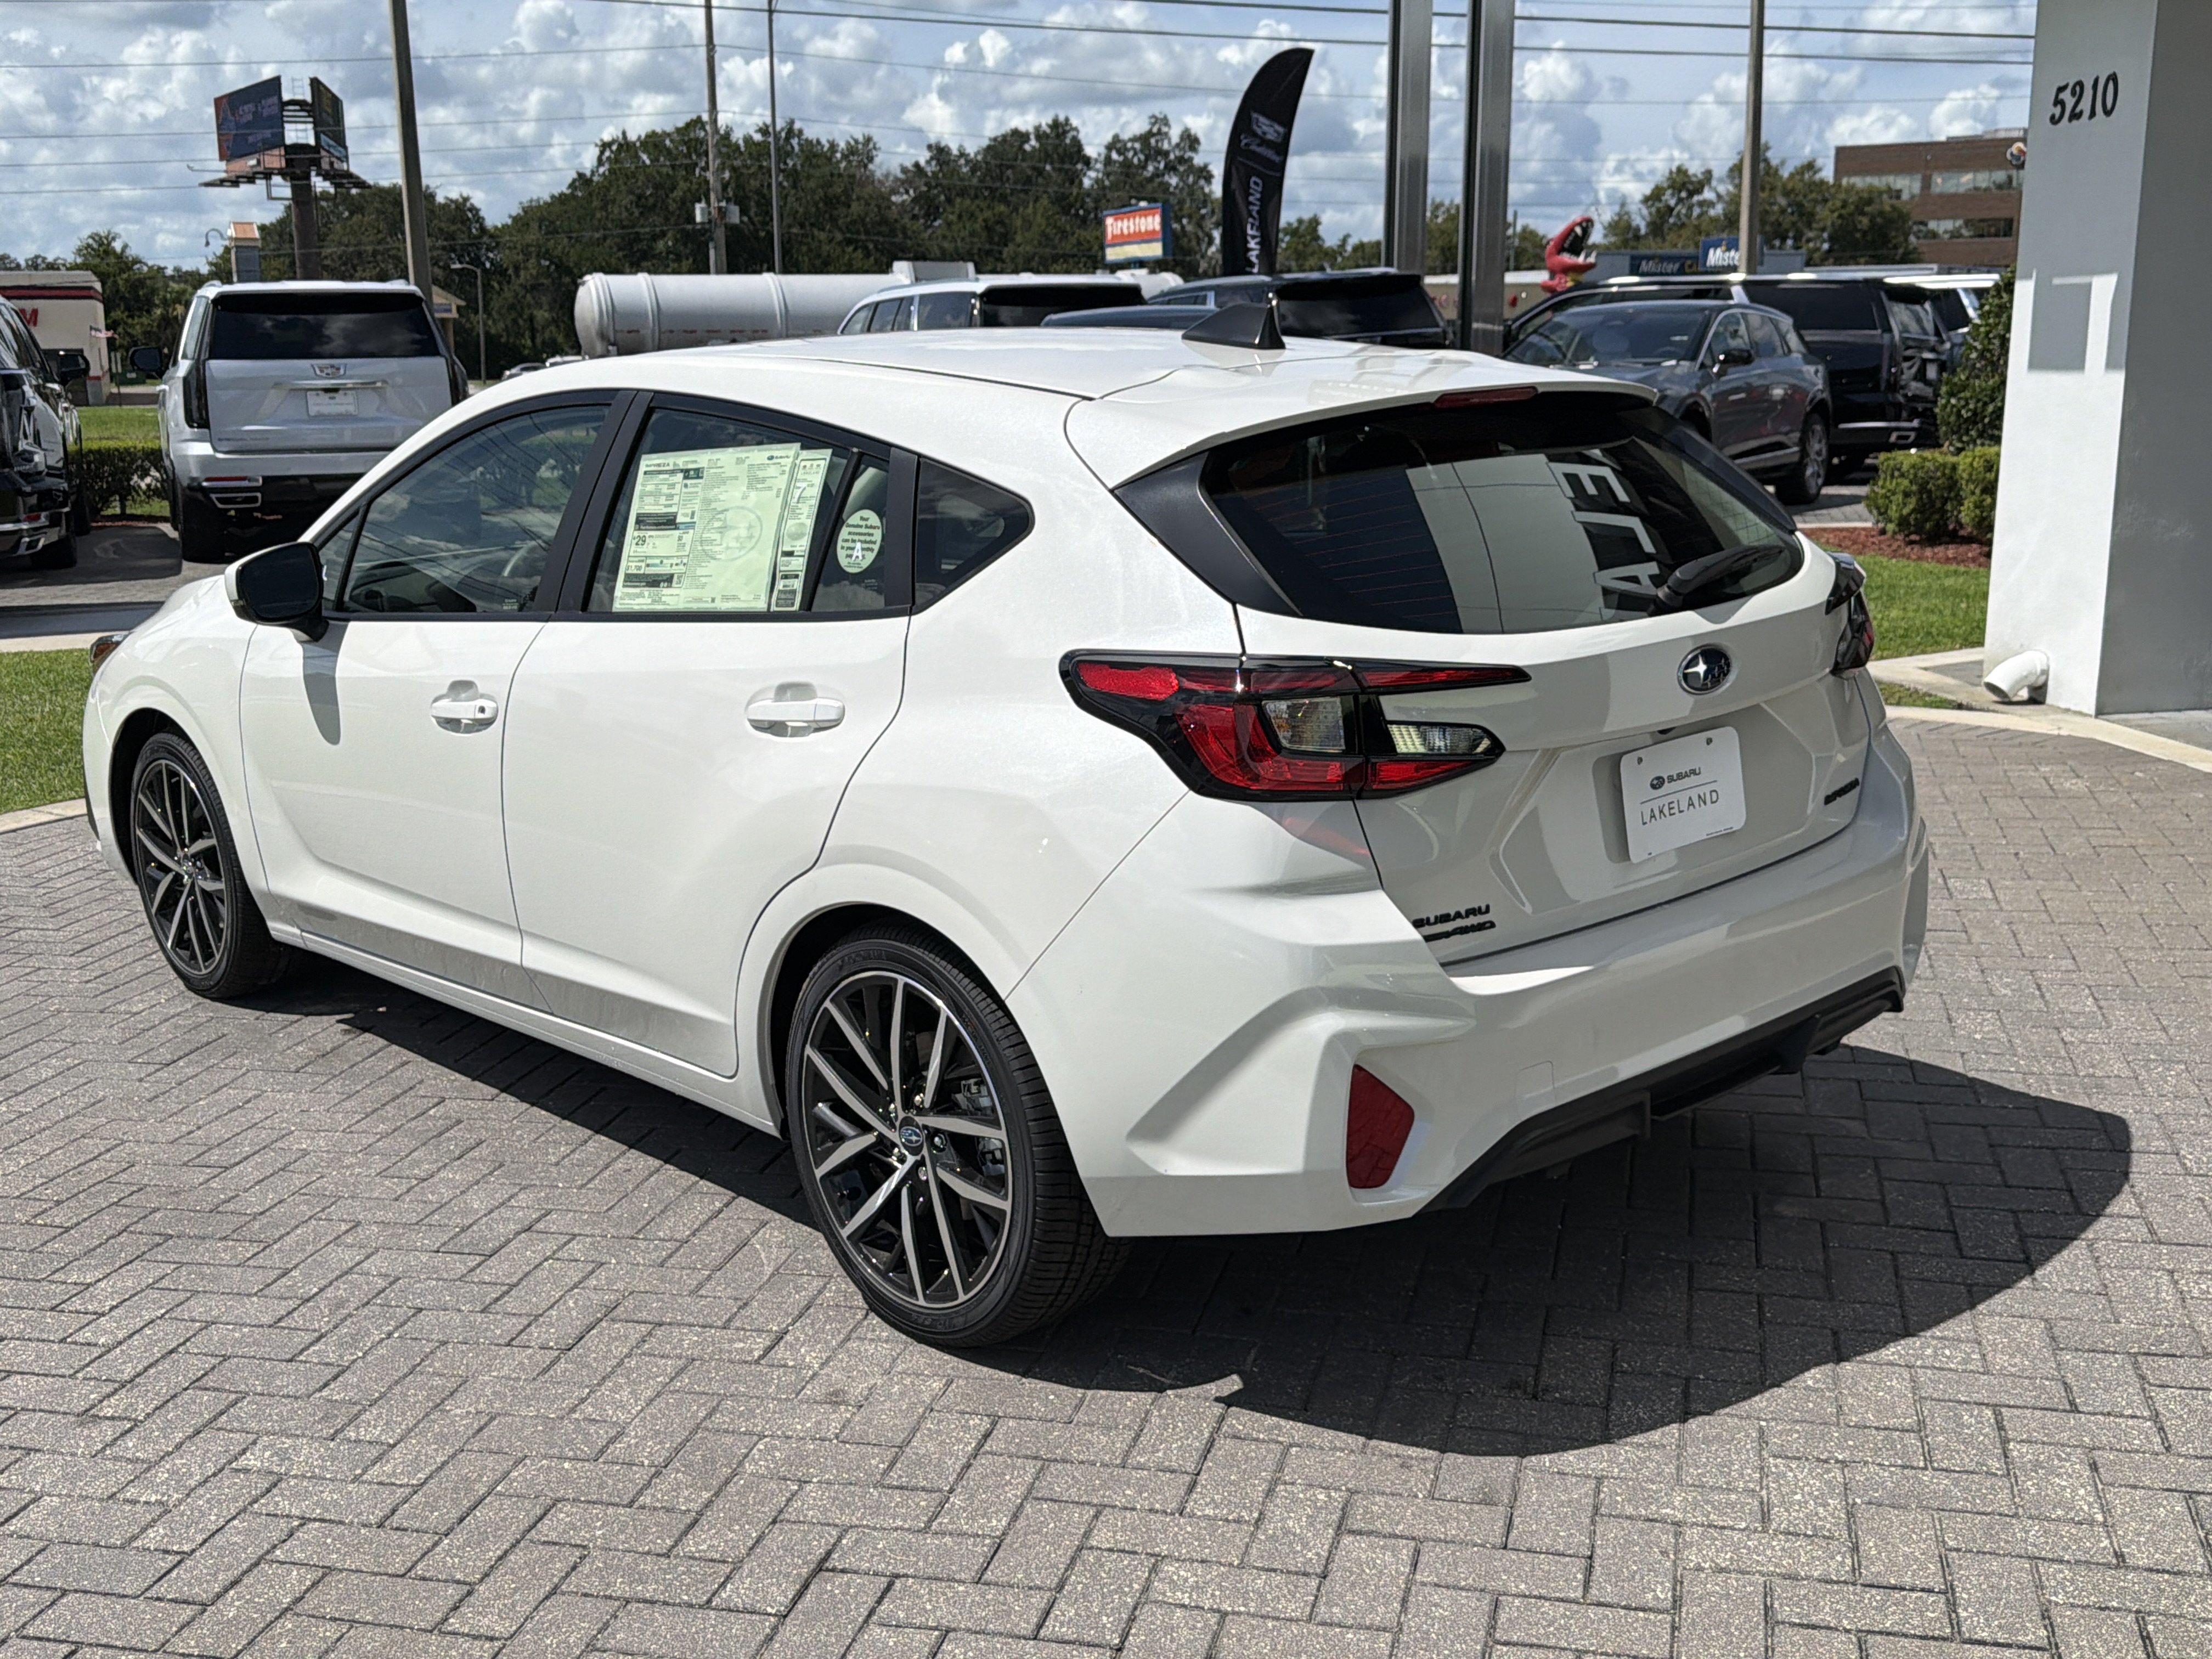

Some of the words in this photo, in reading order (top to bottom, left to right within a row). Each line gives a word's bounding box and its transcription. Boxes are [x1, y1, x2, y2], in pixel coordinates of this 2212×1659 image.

[2049, 71, 2119, 126] 5210
[1105, 213, 1161, 241] Firestone
[1638, 258, 1681, 274] Mister
[1706, 247, 1739, 268] Miste
[1667, 766, 1702, 784] SUBARU
[1640, 789, 1719, 826] LAKELAND
[1412, 903, 1491, 929] SUBARU
